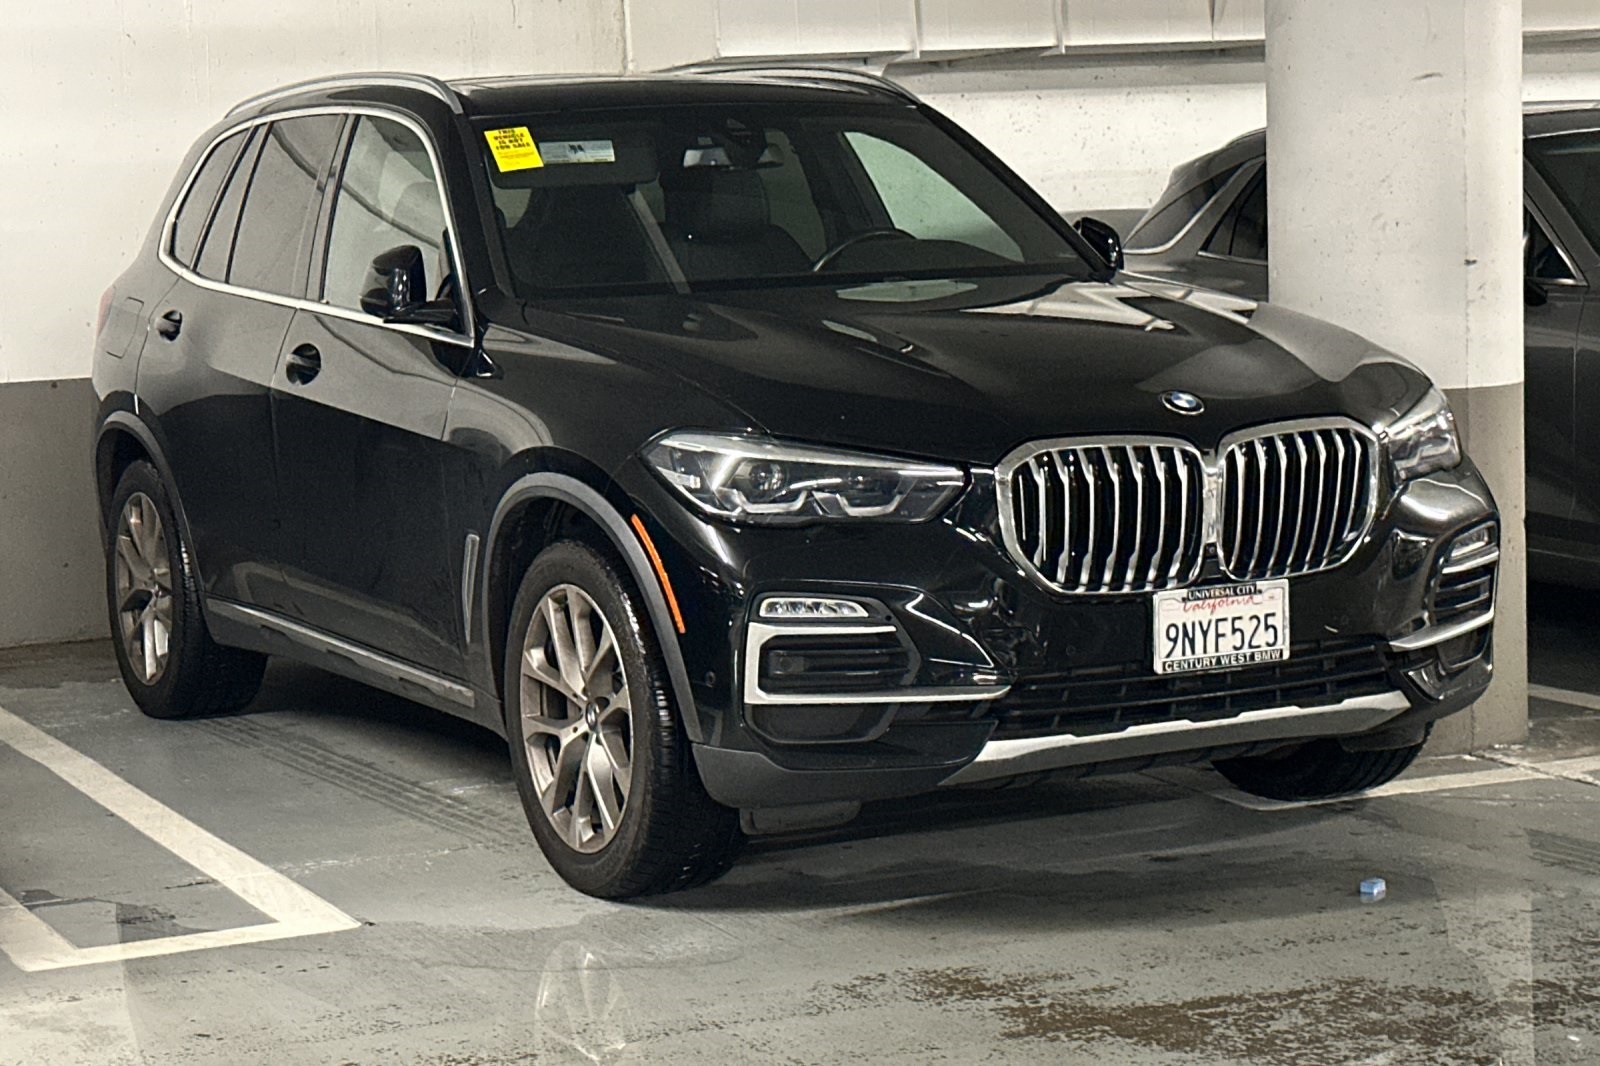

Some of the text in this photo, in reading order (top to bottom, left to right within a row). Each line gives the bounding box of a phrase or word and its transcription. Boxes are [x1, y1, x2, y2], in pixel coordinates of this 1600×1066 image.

[1188, 585, 1256, 600] UNIVERSAL CITY
[1183, 595, 1263, 616] California
[1165, 612, 1278, 659] 9NYF525
[1164, 649, 1281, 672] CENTURY WEST BMW
